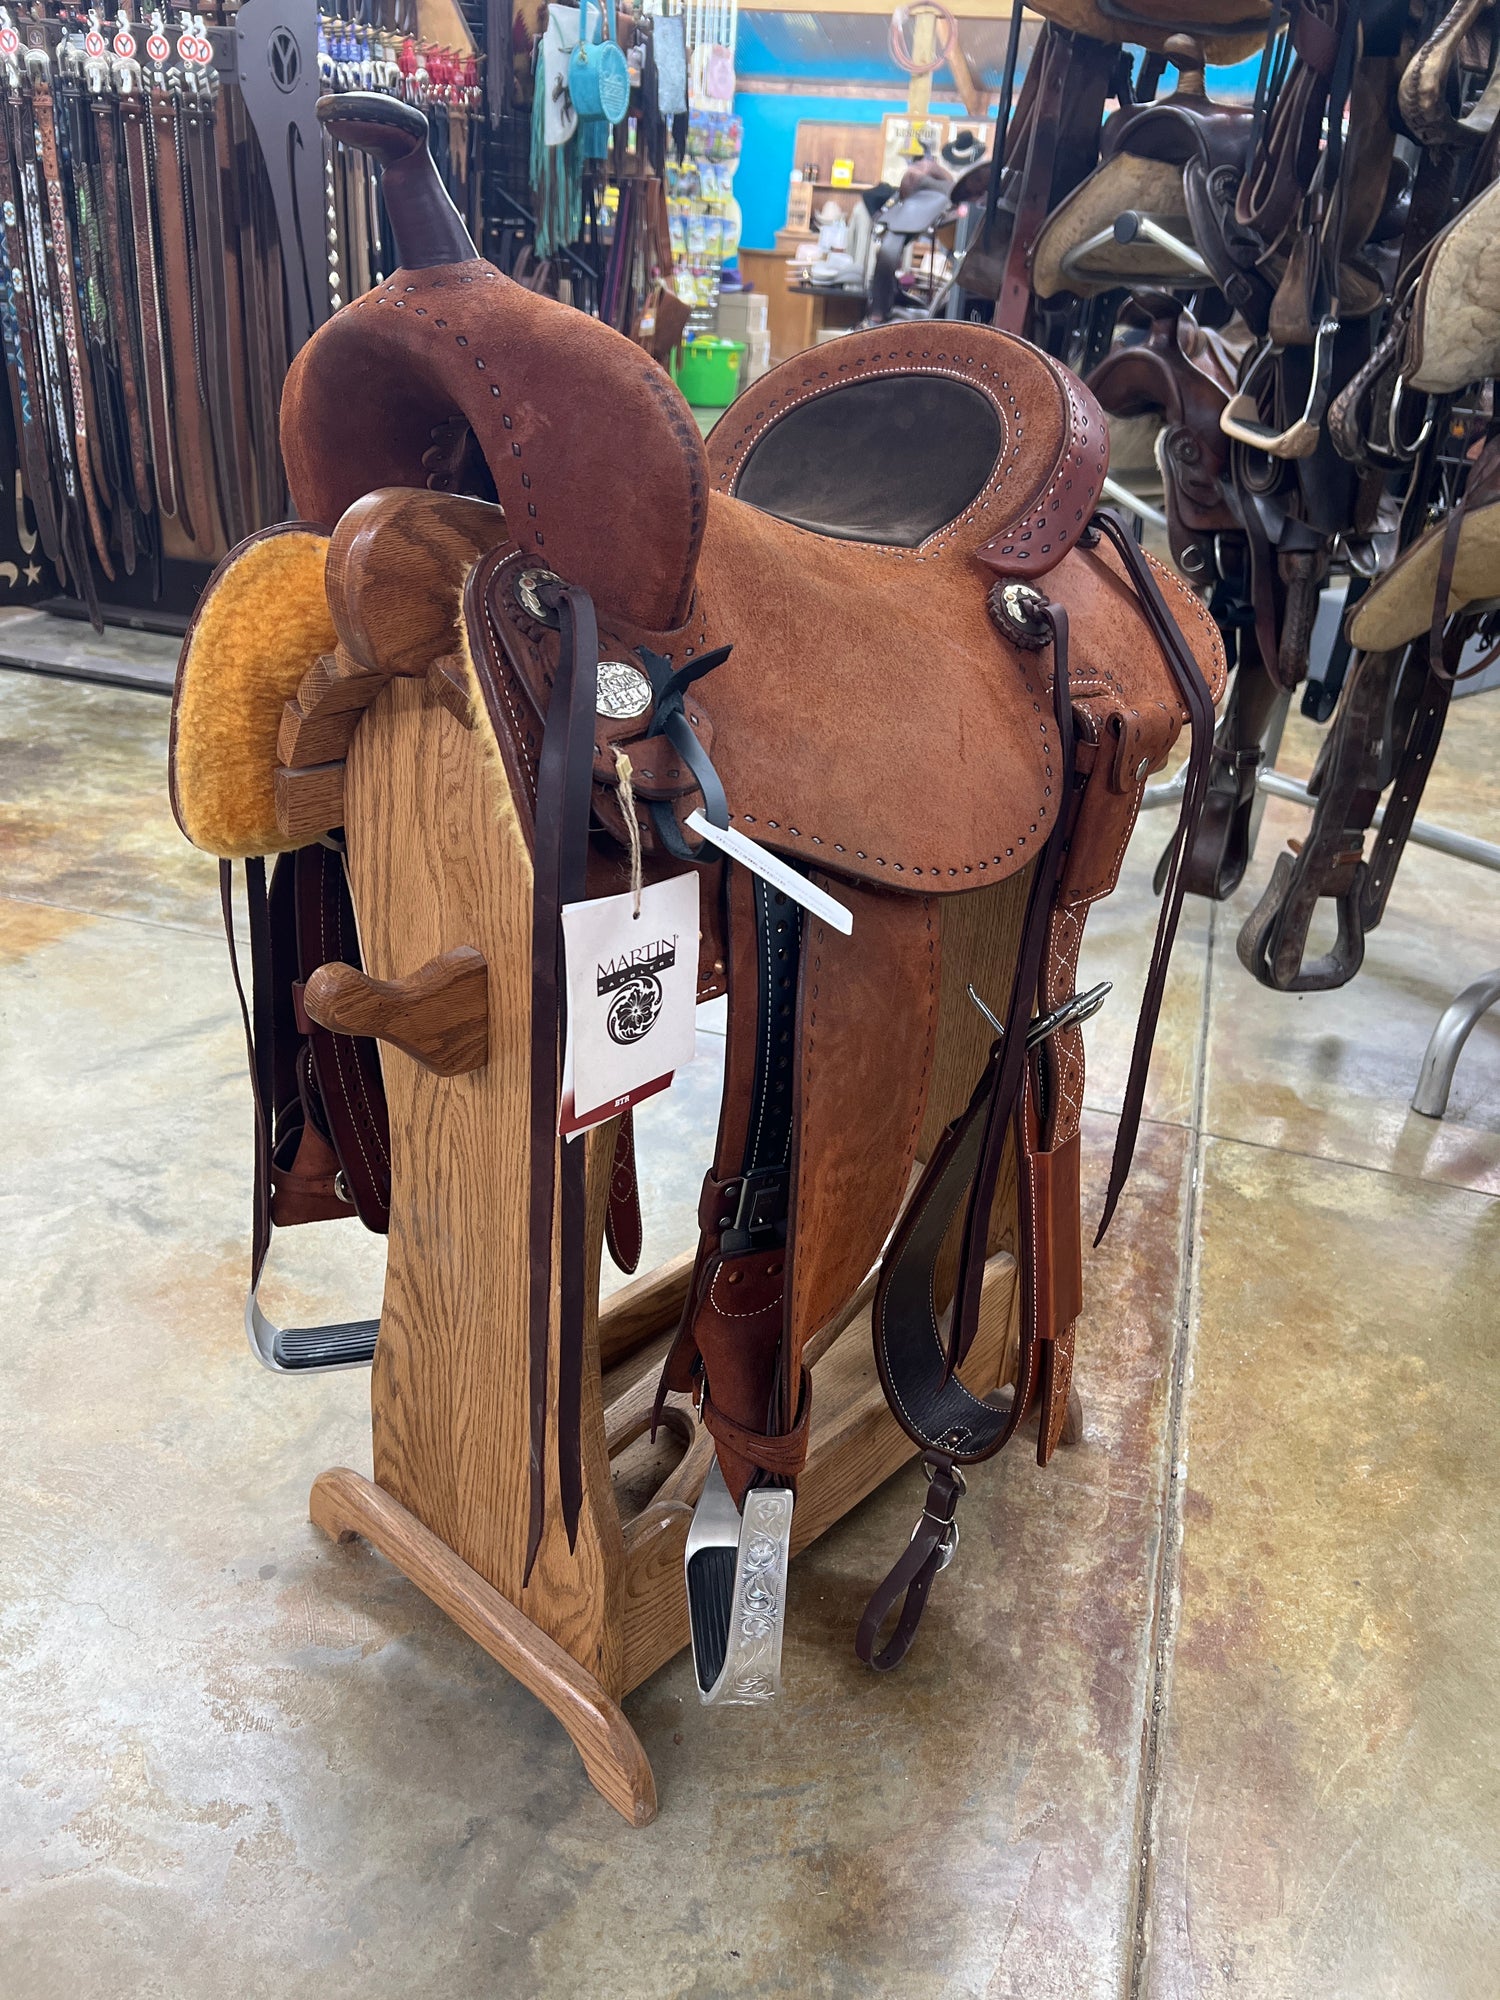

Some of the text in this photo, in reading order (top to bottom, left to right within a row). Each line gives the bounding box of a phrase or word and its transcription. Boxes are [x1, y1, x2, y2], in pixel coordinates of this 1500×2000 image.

[597, 934, 677, 980] MARTIN
[598, 957, 675, 992] SADDLERY
[614, 1094, 630, 1108] BTR
